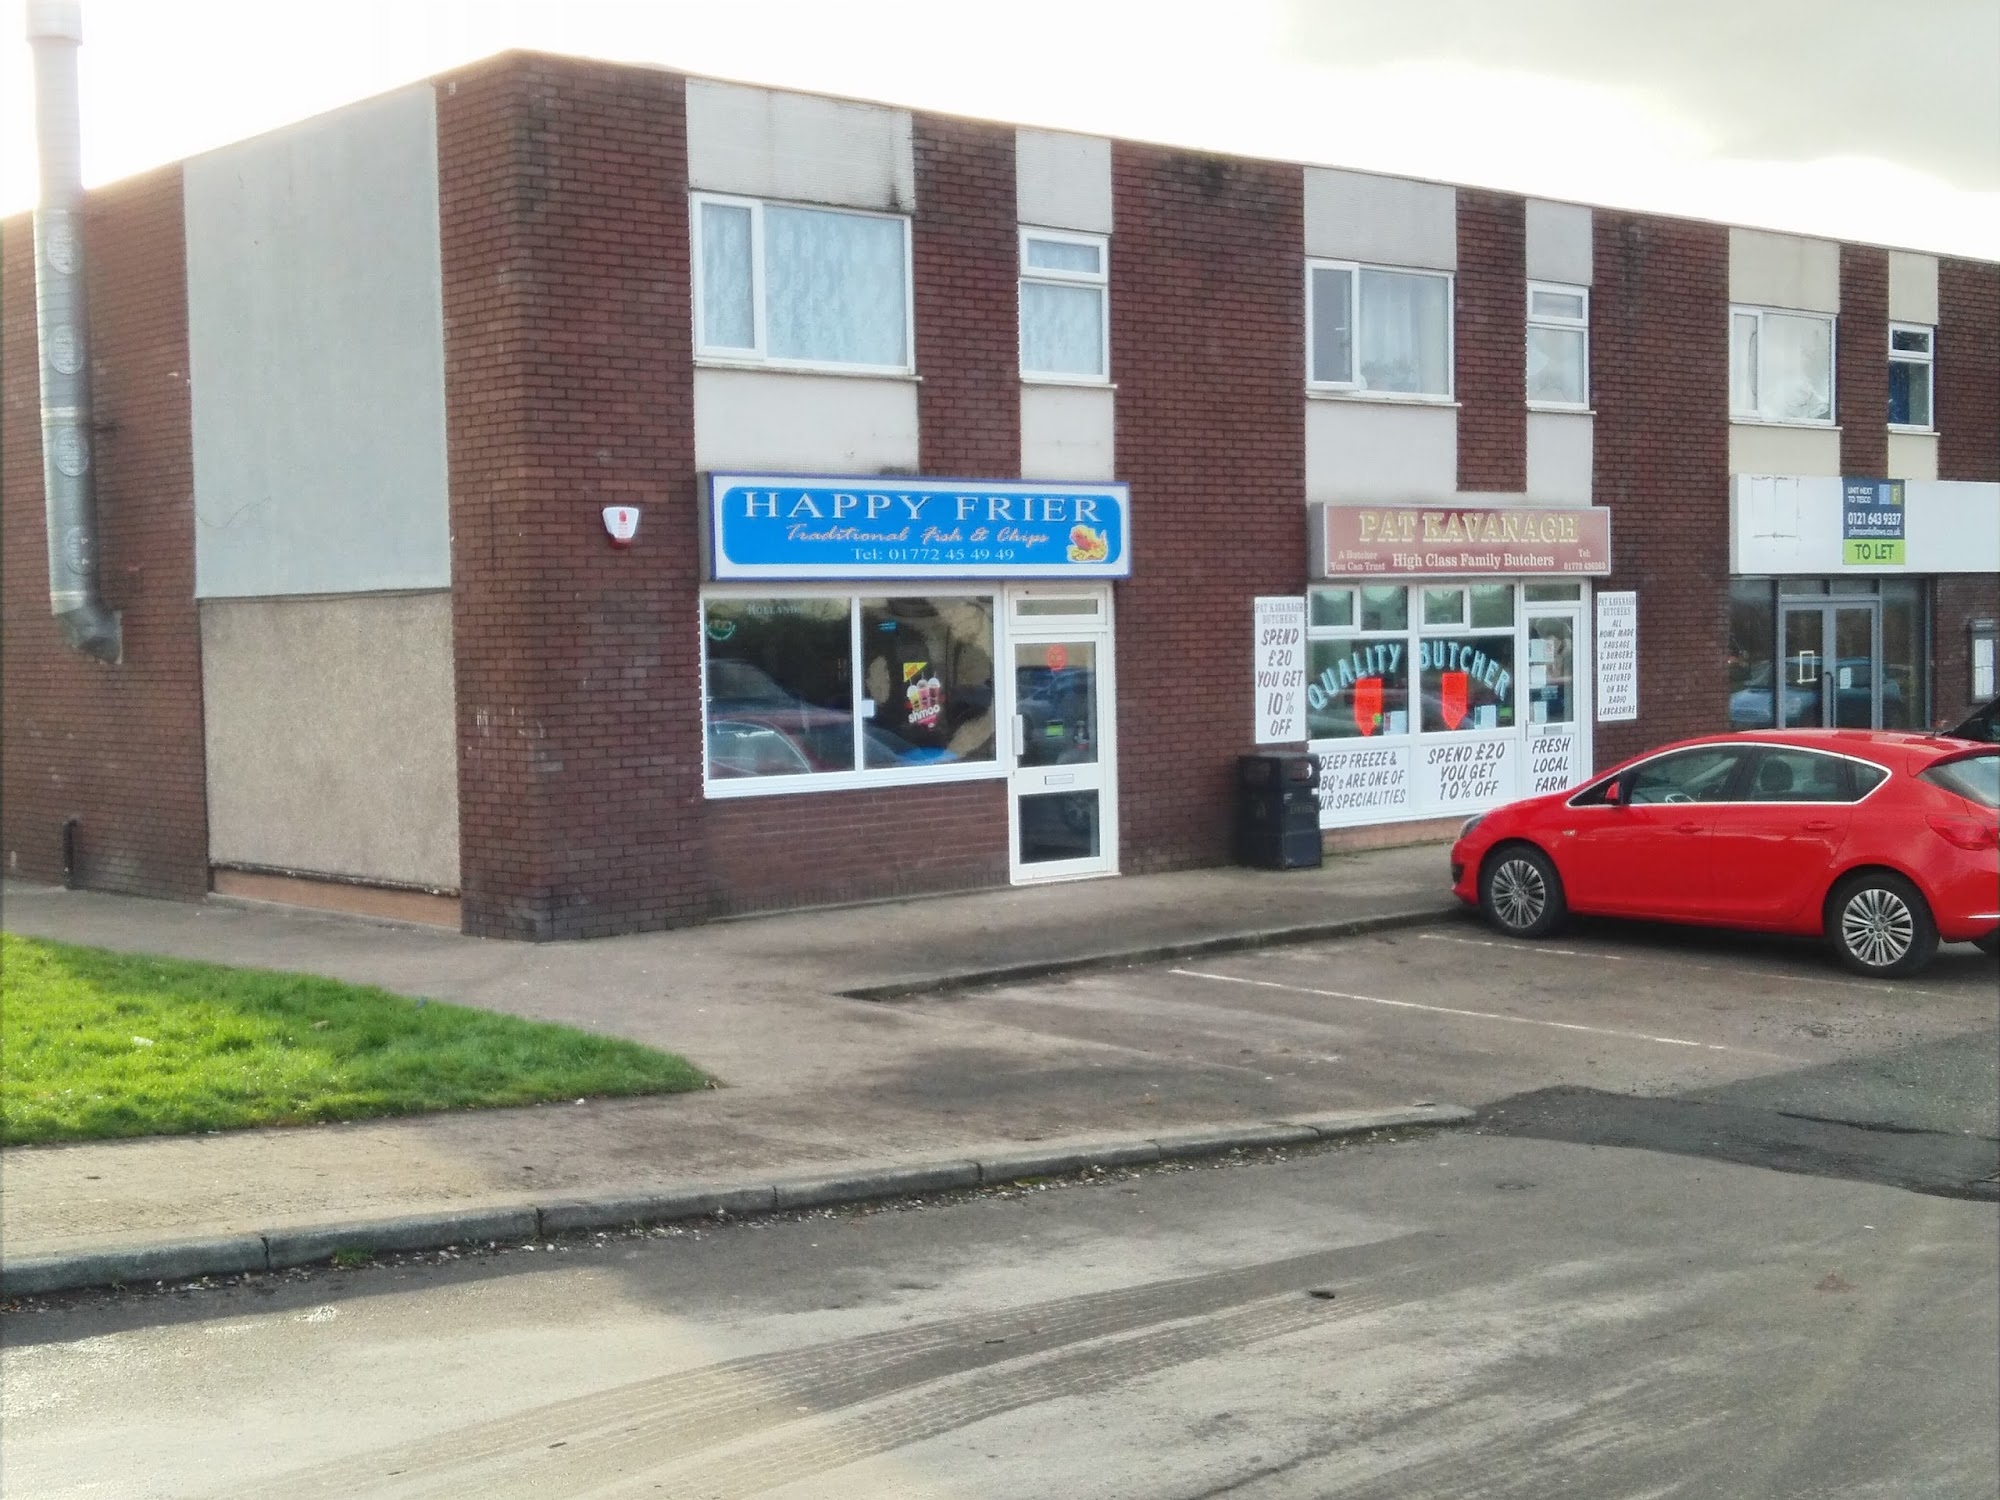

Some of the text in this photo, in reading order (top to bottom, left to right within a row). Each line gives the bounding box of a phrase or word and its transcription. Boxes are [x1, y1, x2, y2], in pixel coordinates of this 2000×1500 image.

[741, 491, 1103, 522] HAPPY FRIER
[1359, 511, 1580, 543] PAT KAVANAGH
[1847, 512, 1902, 526] 0121 643 9337
[786, 523, 1050, 548] Traditional Fish & Chips
[851, 548, 1015, 561] Tel: 01772 45 49 49
[1854, 543, 1895, 560] TO LET
[1364, 562, 1386, 571] Trust
[1392, 553, 1555, 570] High Class Family Butchers
[1612, 619, 1622, 628] ALL
[1261, 628, 1299, 646] SPEND
[1600, 628, 1635, 638] HOME MADE
[1603, 641, 1630, 649] SAUSAGE
[1606, 650, 1634, 660] BURGERS
[1257, 670, 1304, 688] YOU GET
[1307, 640, 1510, 711] QUALITY BUTCHER
[1603, 673, 1632, 683] FEATURED
[908, 704, 940, 723] shmoo
[1600, 705, 1636, 716] LANCASHIRE
[1270, 718, 1292, 737] OFF
[1427, 742, 1505, 765] SPEND £20
[1532, 737, 1572, 755] FRESH
[1320, 751, 1397, 771] DEEP FREEZE &
[1532, 756, 1569, 774] LOCAL
[1320, 769, 1405, 793] BQ's ARE ONE OF
[1440, 762, 1497, 782] YOU GET
[1439, 779, 1499, 800] 10% OFF
[1535, 775, 1569, 793] FARM
[1320, 789, 1406, 811] UR SPECIALITIES
